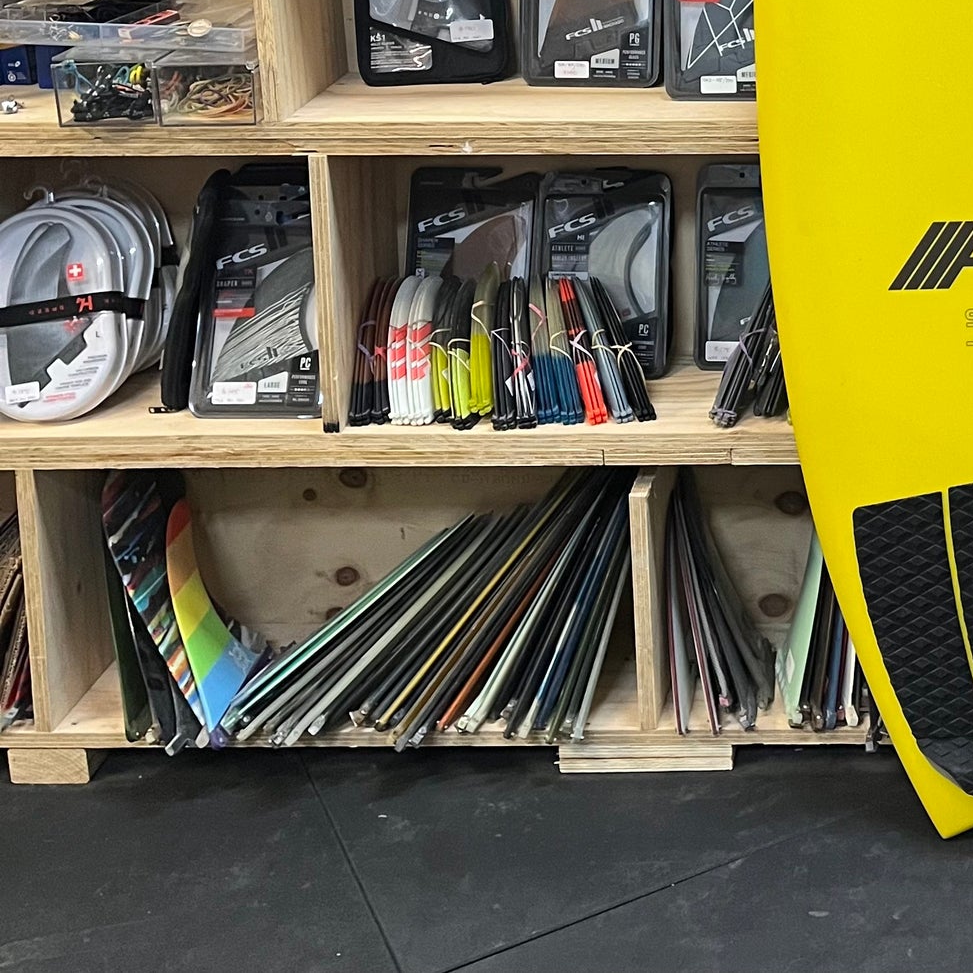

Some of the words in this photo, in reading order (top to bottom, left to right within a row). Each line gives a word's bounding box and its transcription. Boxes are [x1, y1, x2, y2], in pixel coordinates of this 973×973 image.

[629, 32, 640, 43] PG
[418, 207, 466, 232] FCS
[548, 213, 597, 239] FCS
[707, 205, 754, 232] FCS
[216, 243, 267, 270] FCS
[639, 324, 649, 334] PC
[300, 357, 311, 368] PC
